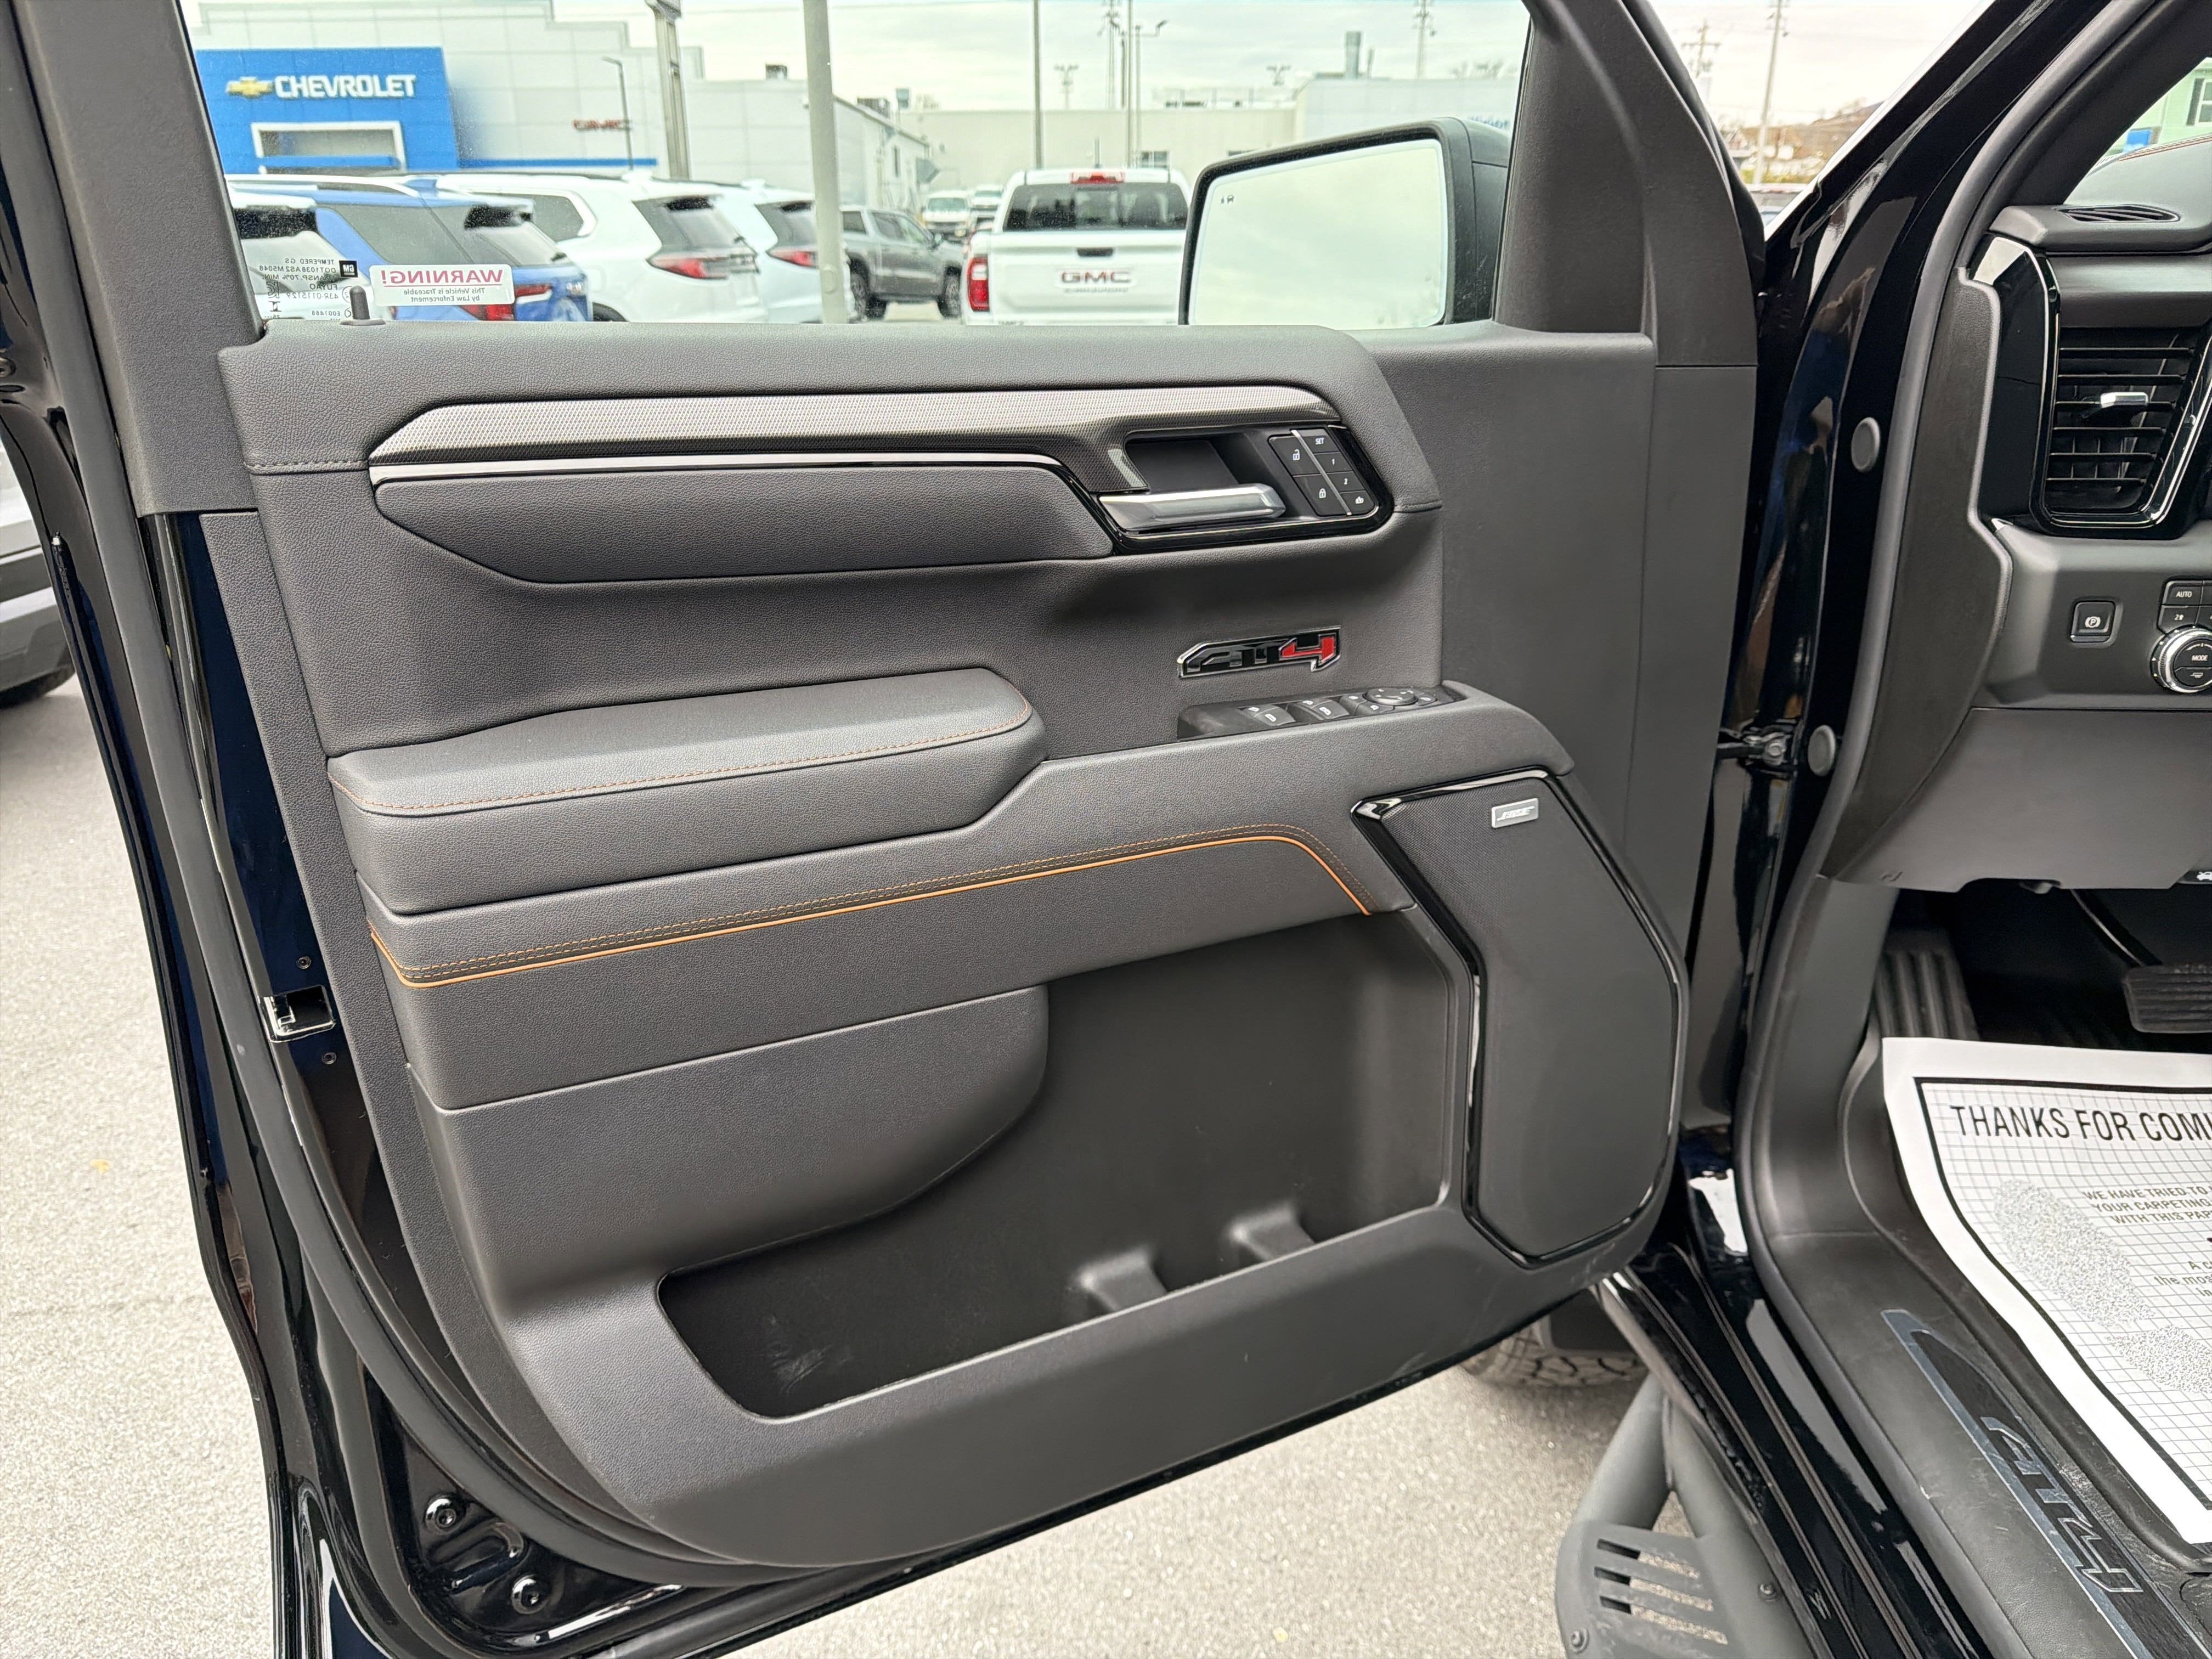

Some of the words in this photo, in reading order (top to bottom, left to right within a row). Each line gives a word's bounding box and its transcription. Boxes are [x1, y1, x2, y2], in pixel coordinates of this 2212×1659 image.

[275, 74, 416, 98] CHEVROLET
[1061, 271, 1131, 284] GMC
[1183, 630, 1339, 674] AT4
[1950, 1105, 2070, 1139] THANKS
[2074, 1109, 2136, 1141] FOR
[2083, 1190, 2108, 1200] WE
[2107, 1188, 2146, 1199] HAVE
[2145, 1187, 2187, 1198] TRIED
[2186, 1186, 2208, 1195] TO
[2091, 1202, 2134, 1212] YOUR
[2109, 1214, 2150, 1224] WITH
[2149, 1212, 2185, 1222] THIS
[2185, 1210, 2212, 1220] PAP
[2187, 1261, 2202, 1270] A
[2154, 1275, 2181, 1285] the
[2181, 1274, 2212, 1285] mos
[1980, 1416, 2143, 1593] AT4
